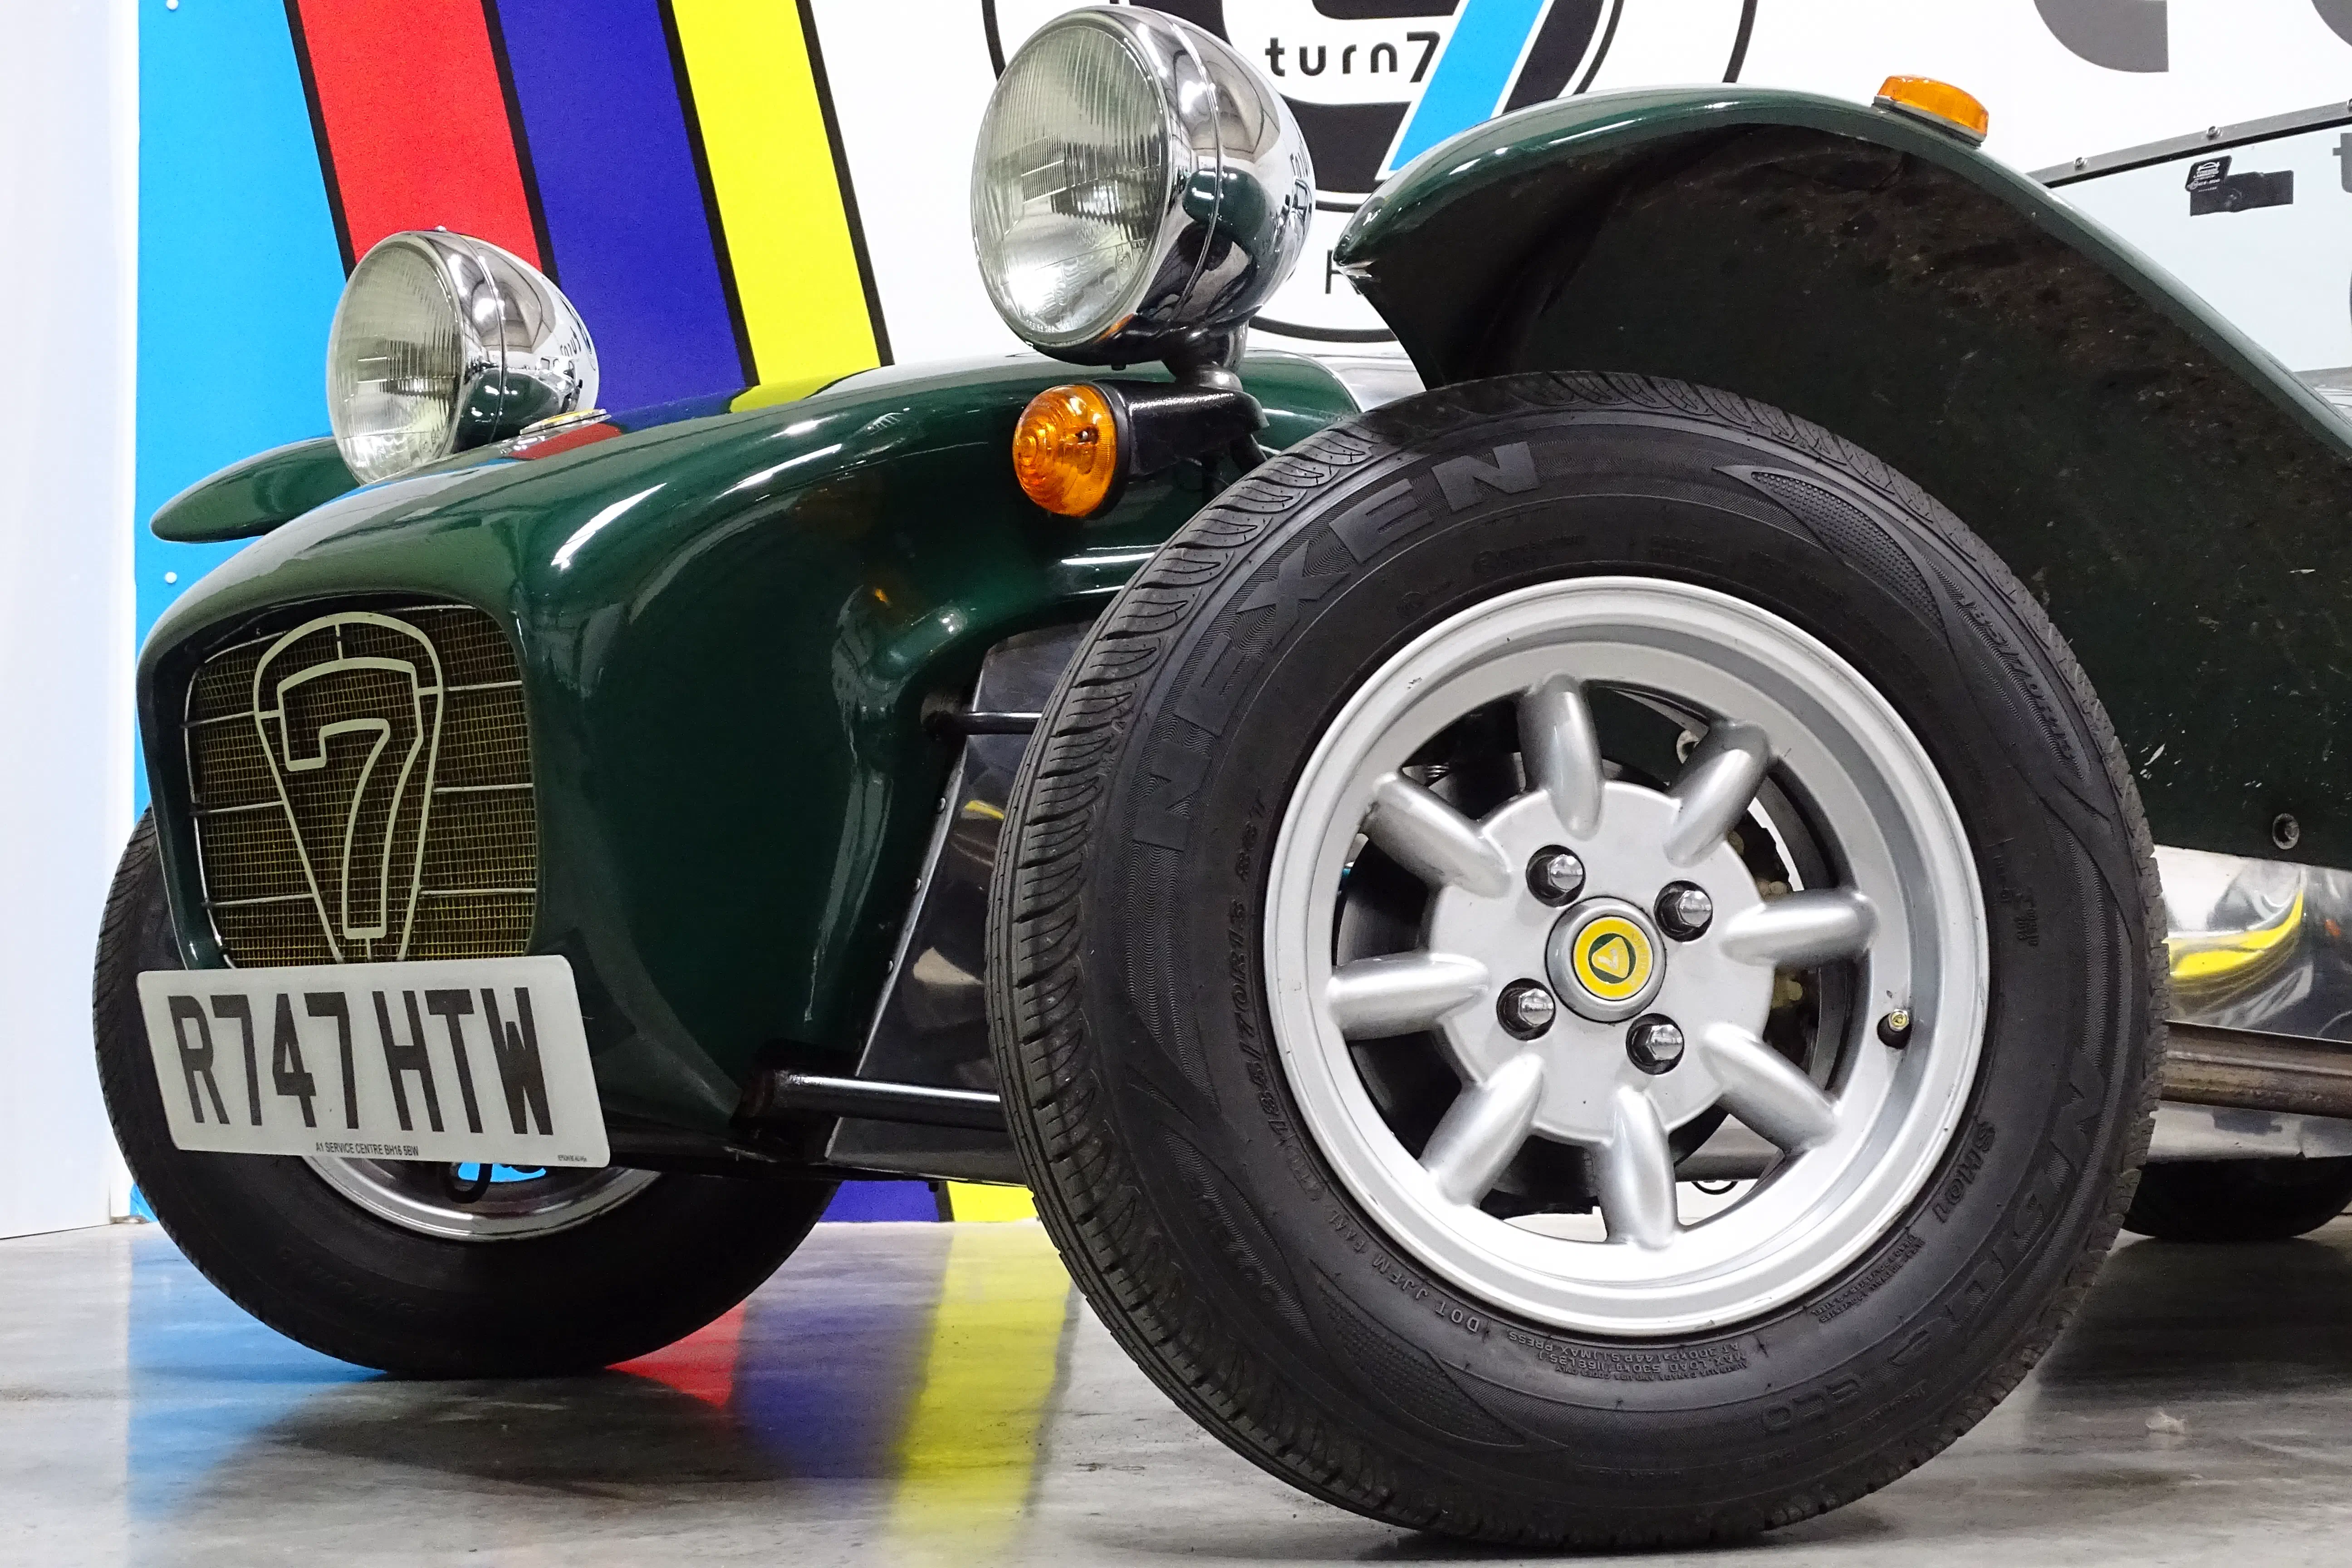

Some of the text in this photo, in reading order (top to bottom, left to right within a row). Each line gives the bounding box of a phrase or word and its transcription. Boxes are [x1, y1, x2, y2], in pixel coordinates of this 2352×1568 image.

[1265, 30, 1441, 83] turn7
[1132, 441, 1541, 852] NEXEN
[1958, 600, 2077, 765] 185/70R13
[167, 987, 554, 1135] R747 HTW
[316, 1142, 324, 1152] A1
[325, 1142, 354, 1153] SERVICE
[355, 1143, 383, 1155] CENTRE
[384, 1145, 402, 1156] BH16
[1435, 1301, 1480, 1333] DOT
[1509, 1332, 1553, 1351] PRESS
[1669, 1358, 1706, 1374] LOAD
